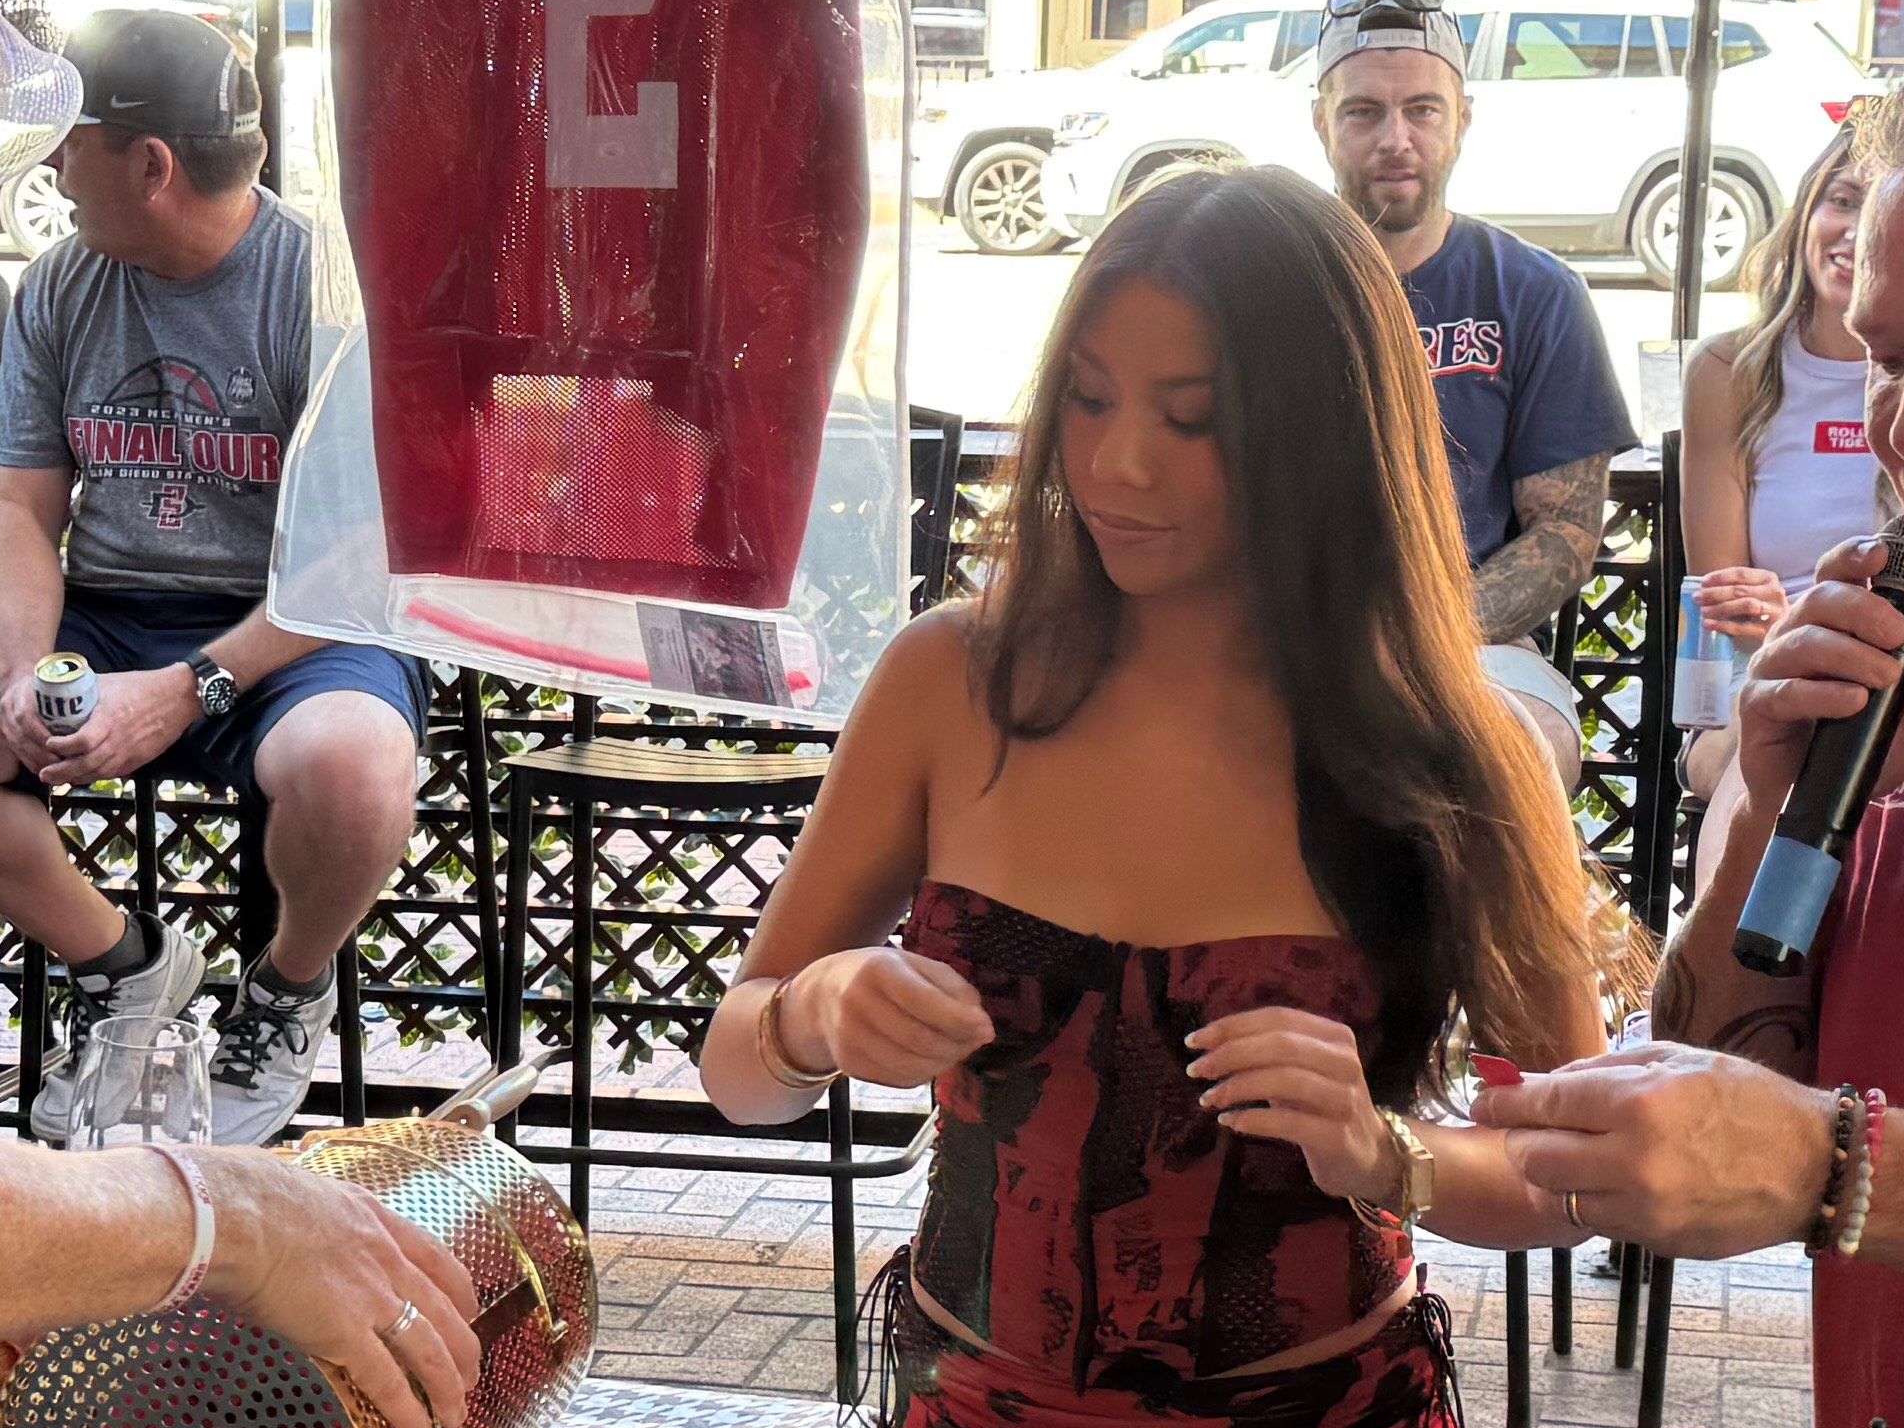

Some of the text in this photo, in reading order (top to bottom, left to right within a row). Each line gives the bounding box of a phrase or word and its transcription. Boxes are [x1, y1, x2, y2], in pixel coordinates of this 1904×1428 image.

[1415, 316, 1503, 378] RES
[66, 417, 281, 483] FINAL OUR
